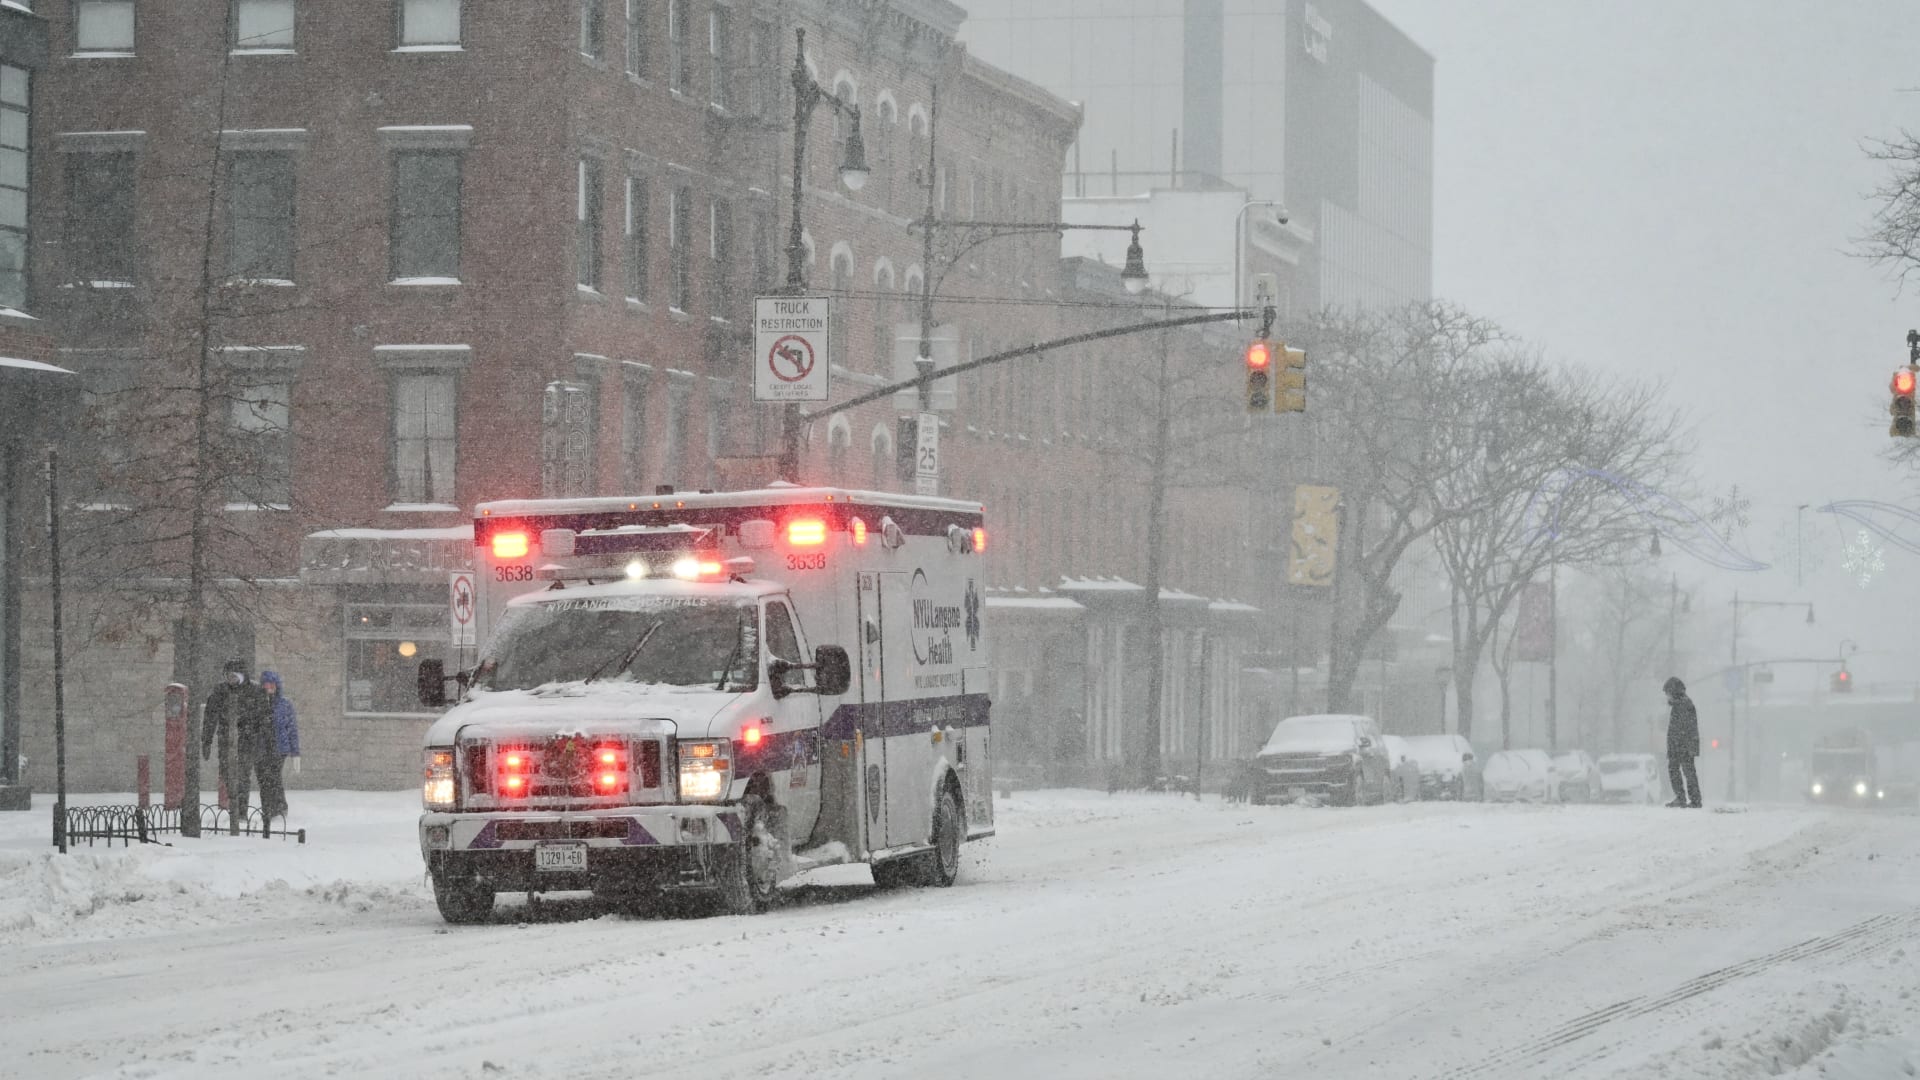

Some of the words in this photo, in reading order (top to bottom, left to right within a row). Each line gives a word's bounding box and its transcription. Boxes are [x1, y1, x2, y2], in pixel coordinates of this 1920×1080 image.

[774, 302, 810, 314] TRUCK
[761, 318, 823, 329] RESTRICTION
[565, 390, 588, 497] BAR
[920, 446, 936, 470] 25
[787, 553, 826, 570] 3638
[495, 565, 533, 582] 3638
[546, 600, 571, 612] NYU
[913, 599, 930, 629] NYU
[930, 600, 961, 635] Langone
[928, 635, 953, 665] Health
